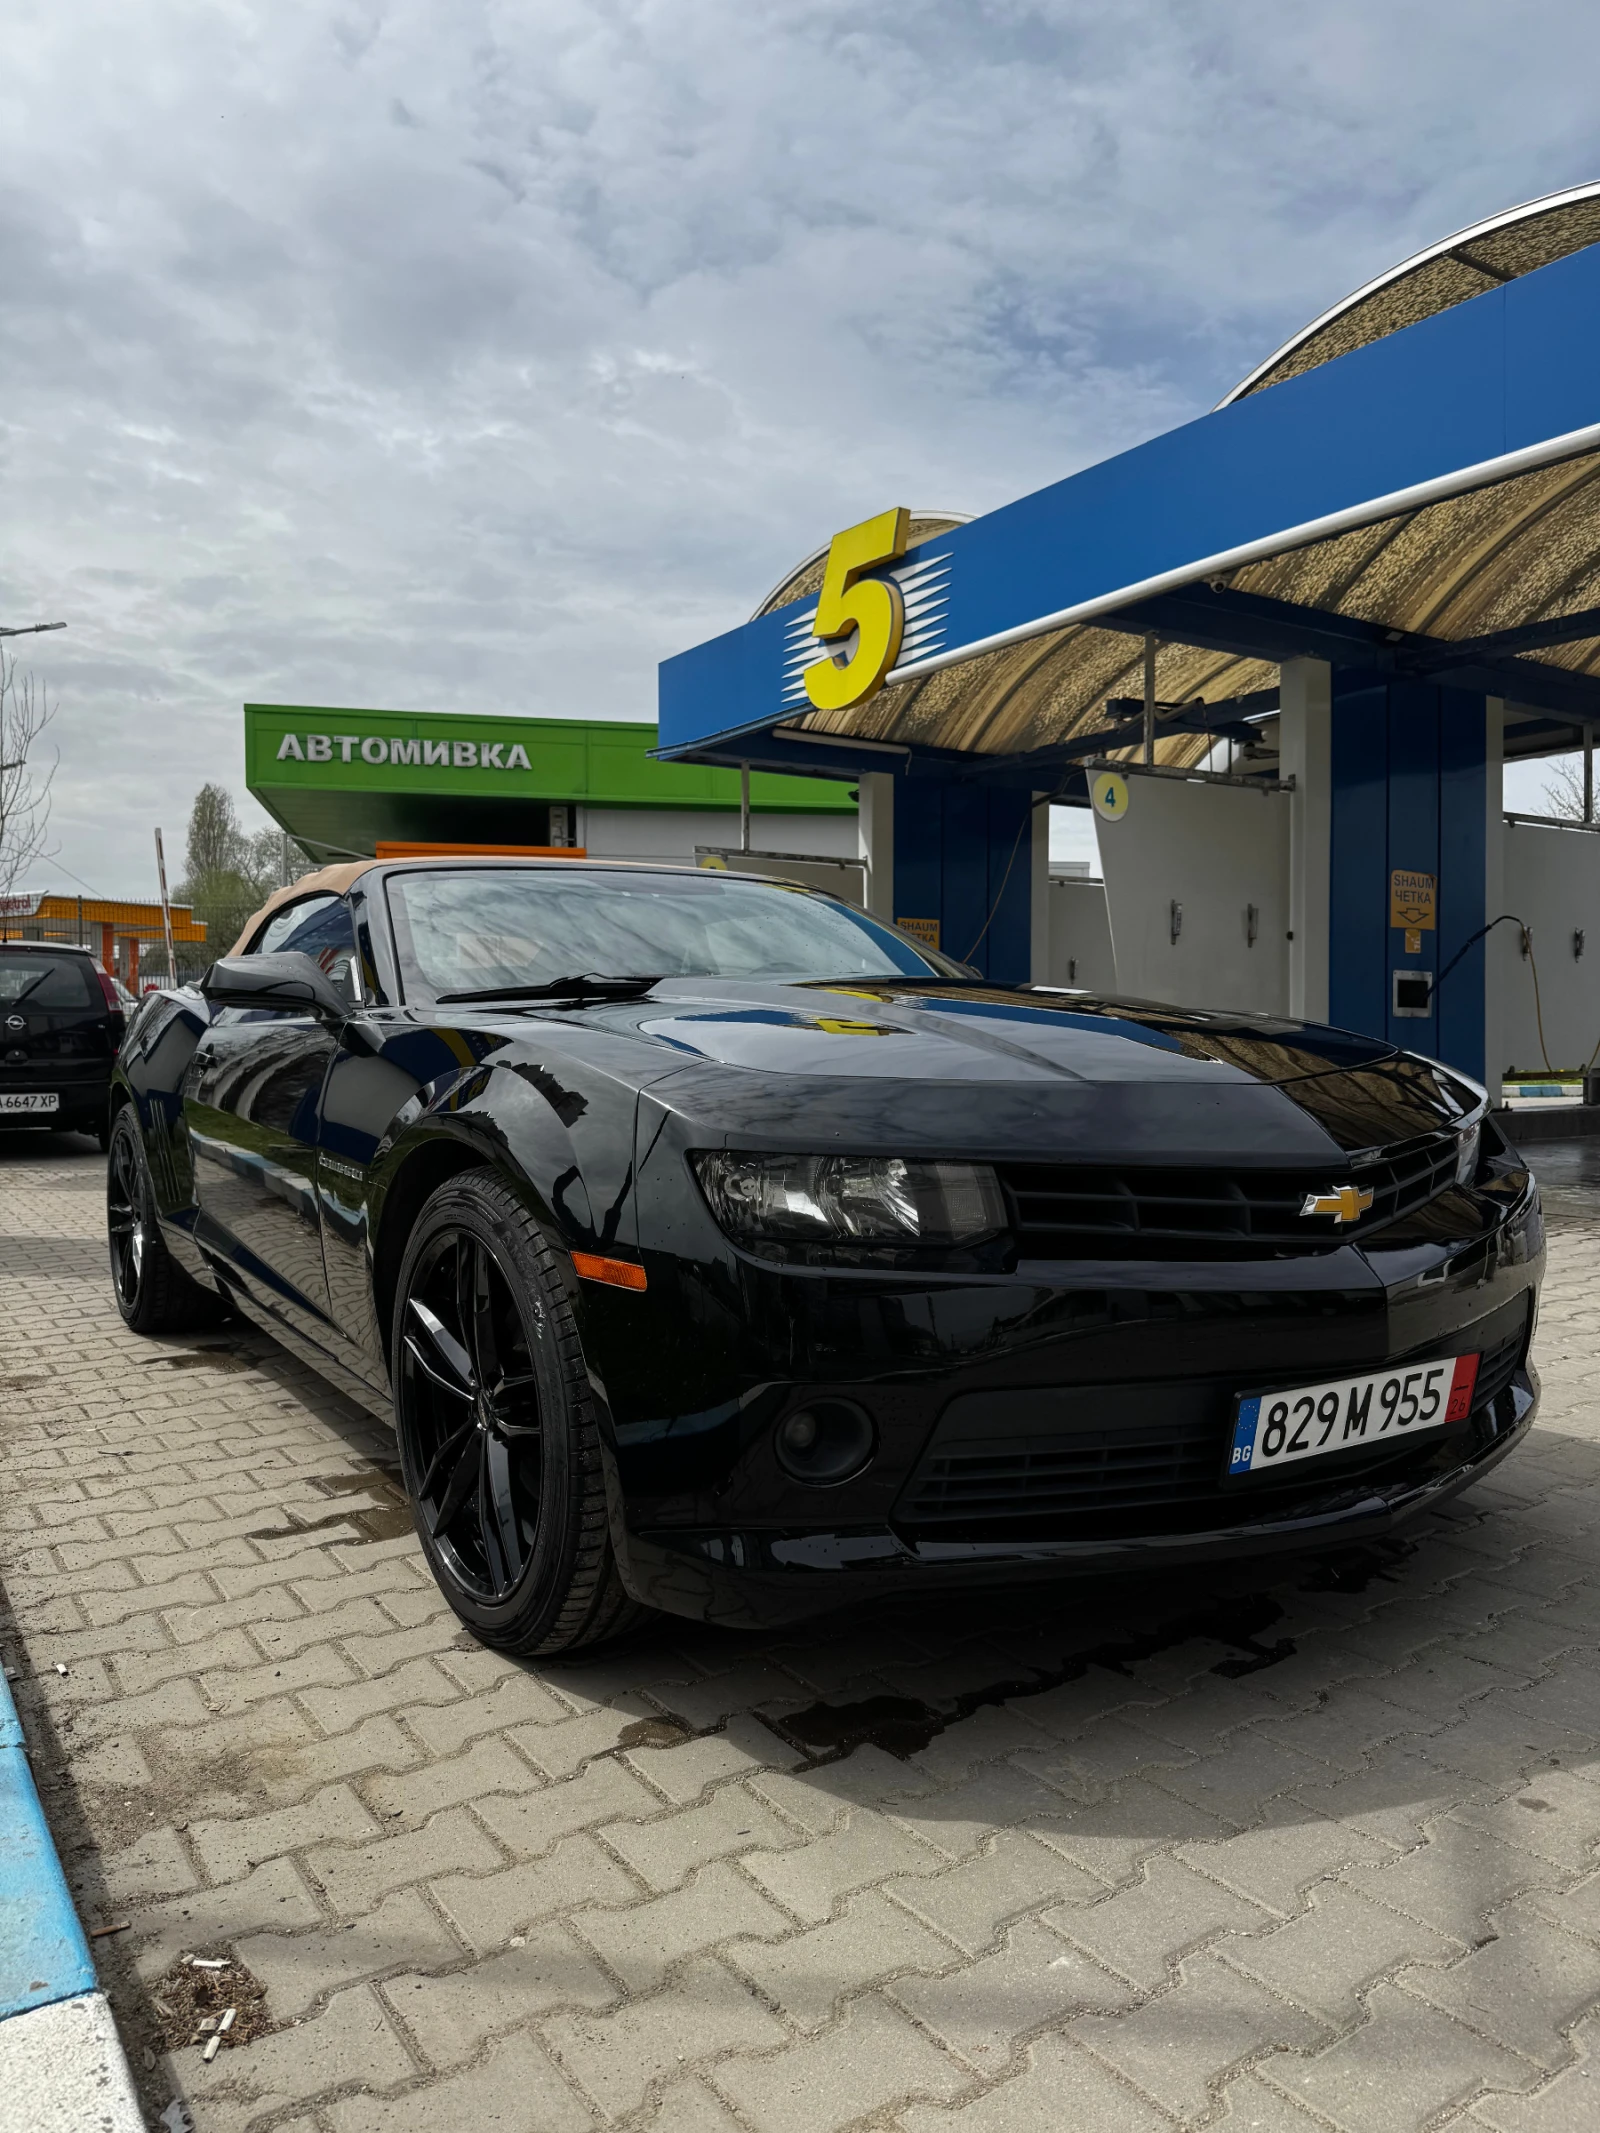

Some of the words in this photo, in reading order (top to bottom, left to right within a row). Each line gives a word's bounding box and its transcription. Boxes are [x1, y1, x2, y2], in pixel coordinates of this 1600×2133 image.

[804, 507, 911, 711] 5
[276, 734, 533, 770] АВТОМИВКА
[1105, 786, 1116, 808] 4
[1394, 874, 1434, 890] SHAUM
[1395, 889, 1431, 904] ЧЕТКА
[6, 1096, 38, 1108] 6647
[1261, 1391, 1340, 1457] 829
[1342, 1383, 1374, 1441] M
[1378, 1368, 1445, 1433] 955
[1449, 1397, 1466, 1415] 26
[1231, 1445, 1251, 1465] BG
